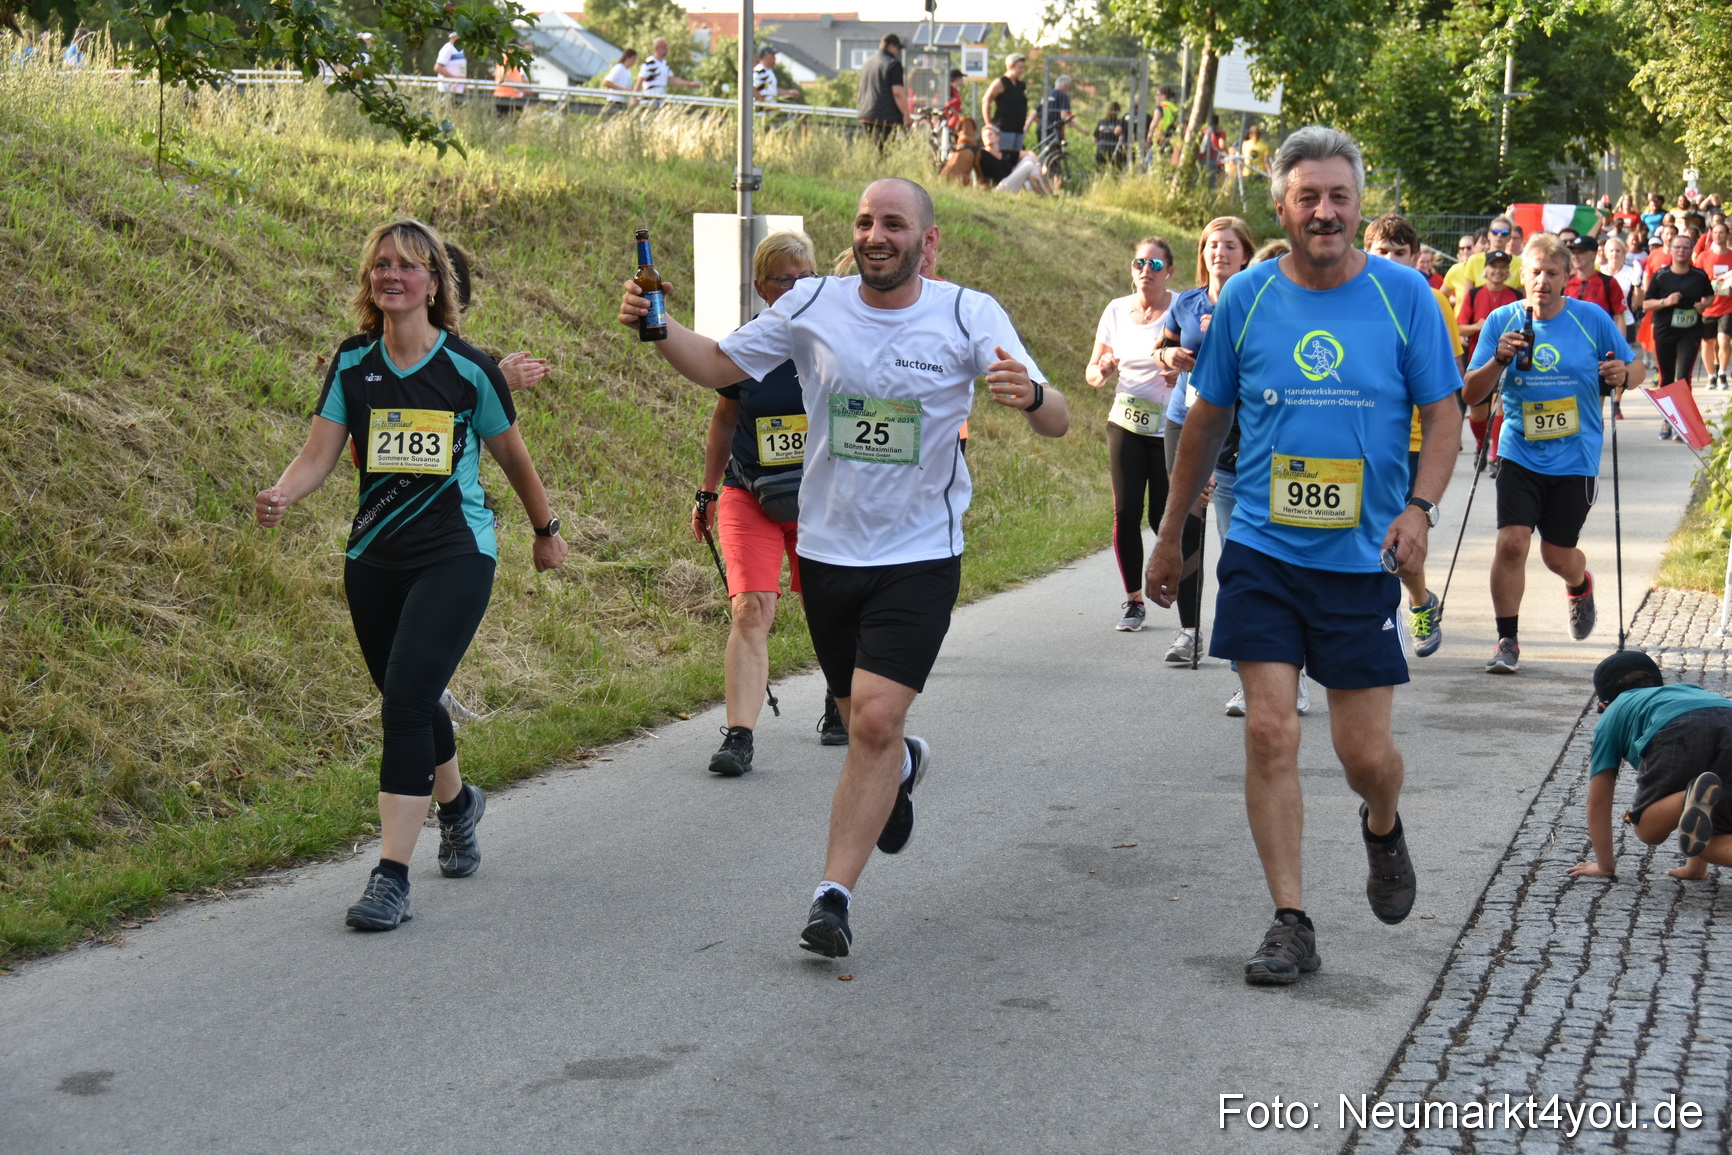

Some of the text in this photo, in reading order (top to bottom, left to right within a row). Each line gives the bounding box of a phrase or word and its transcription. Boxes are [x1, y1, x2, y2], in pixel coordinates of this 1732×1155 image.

[895, 359, 943, 373] auctores
[1284, 387, 1360, 396] Handwerkskammer
[1284, 397, 1375, 408] Niederbayern-Oberpfalz
[1124, 408, 1150, 425] 656
[1535, 413, 1567, 429] 976
[855, 420, 889, 445] 25
[377, 431, 441, 456] 2183
[843, 442, 902, 453] Böhm Maximilian
[1287, 481, 1340, 509] 986
[1282, 506, 1313, 515] Hertwich
